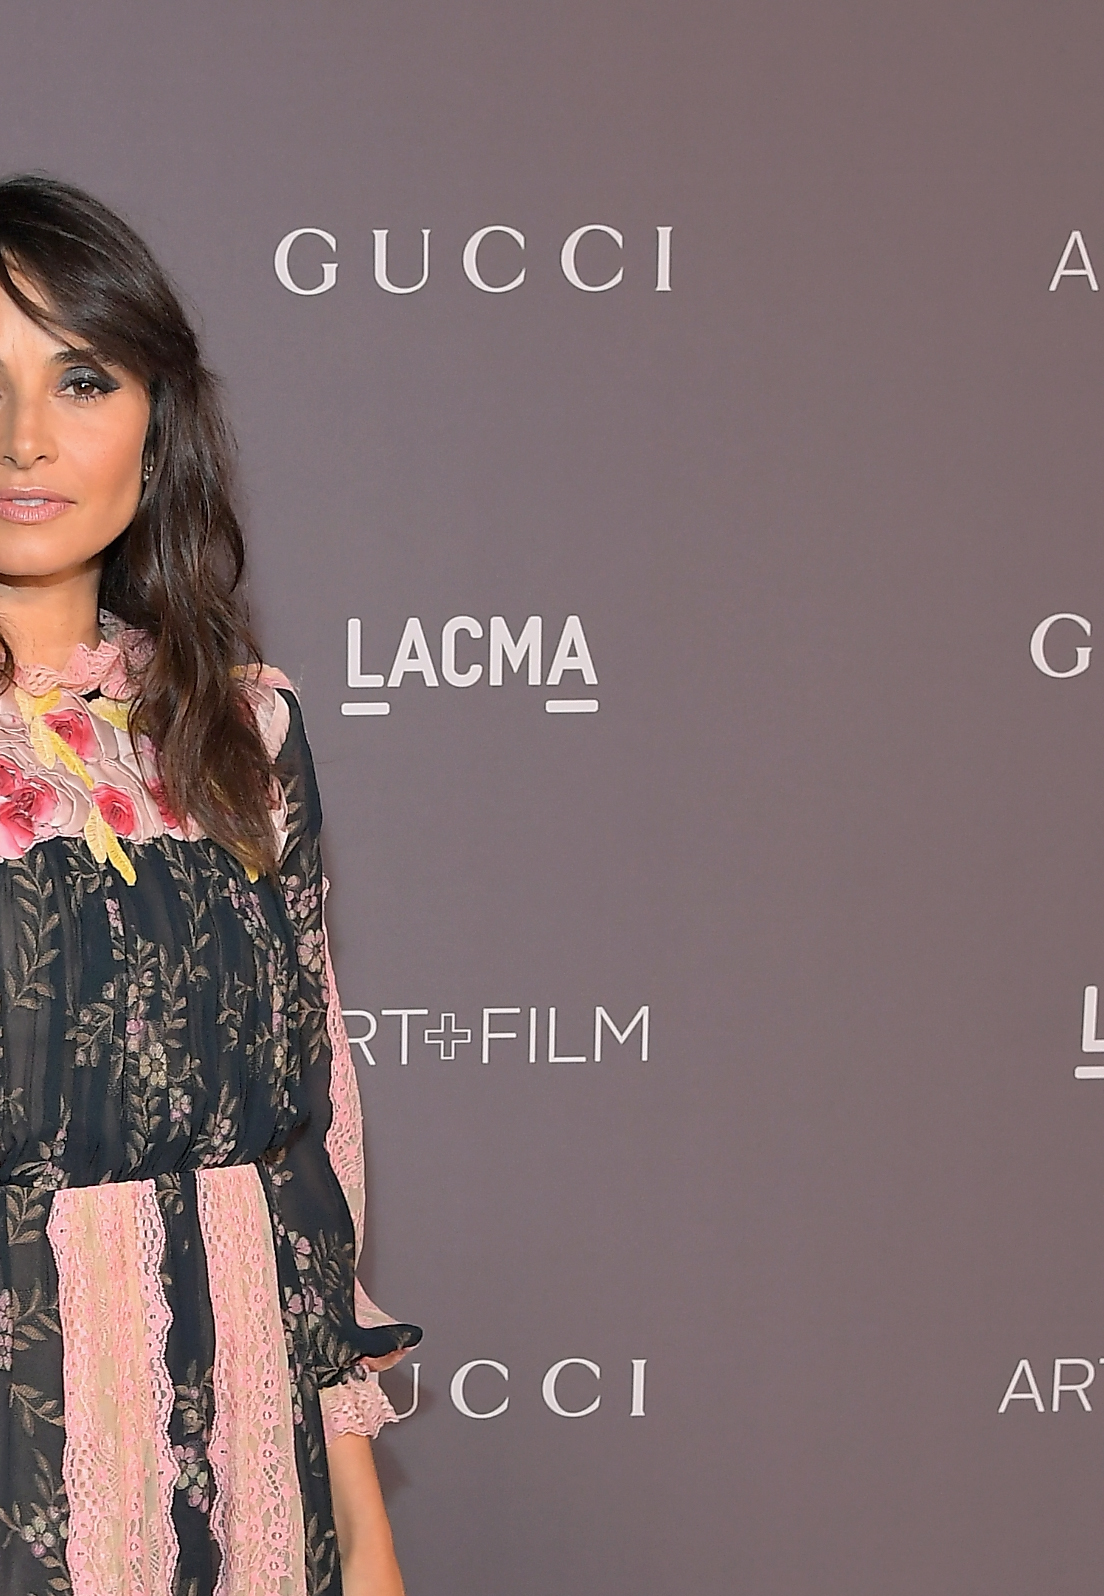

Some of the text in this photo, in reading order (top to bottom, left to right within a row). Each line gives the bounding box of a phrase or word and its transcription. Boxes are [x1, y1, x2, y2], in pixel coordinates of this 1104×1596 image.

[274, 224, 673, 296] GUCCI
[1049, 230, 1099, 292] A
[347, 615, 598, 688] LACMA
[1030, 613, 1093, 678] G
[997, 1357, 1104, 1414] AR
